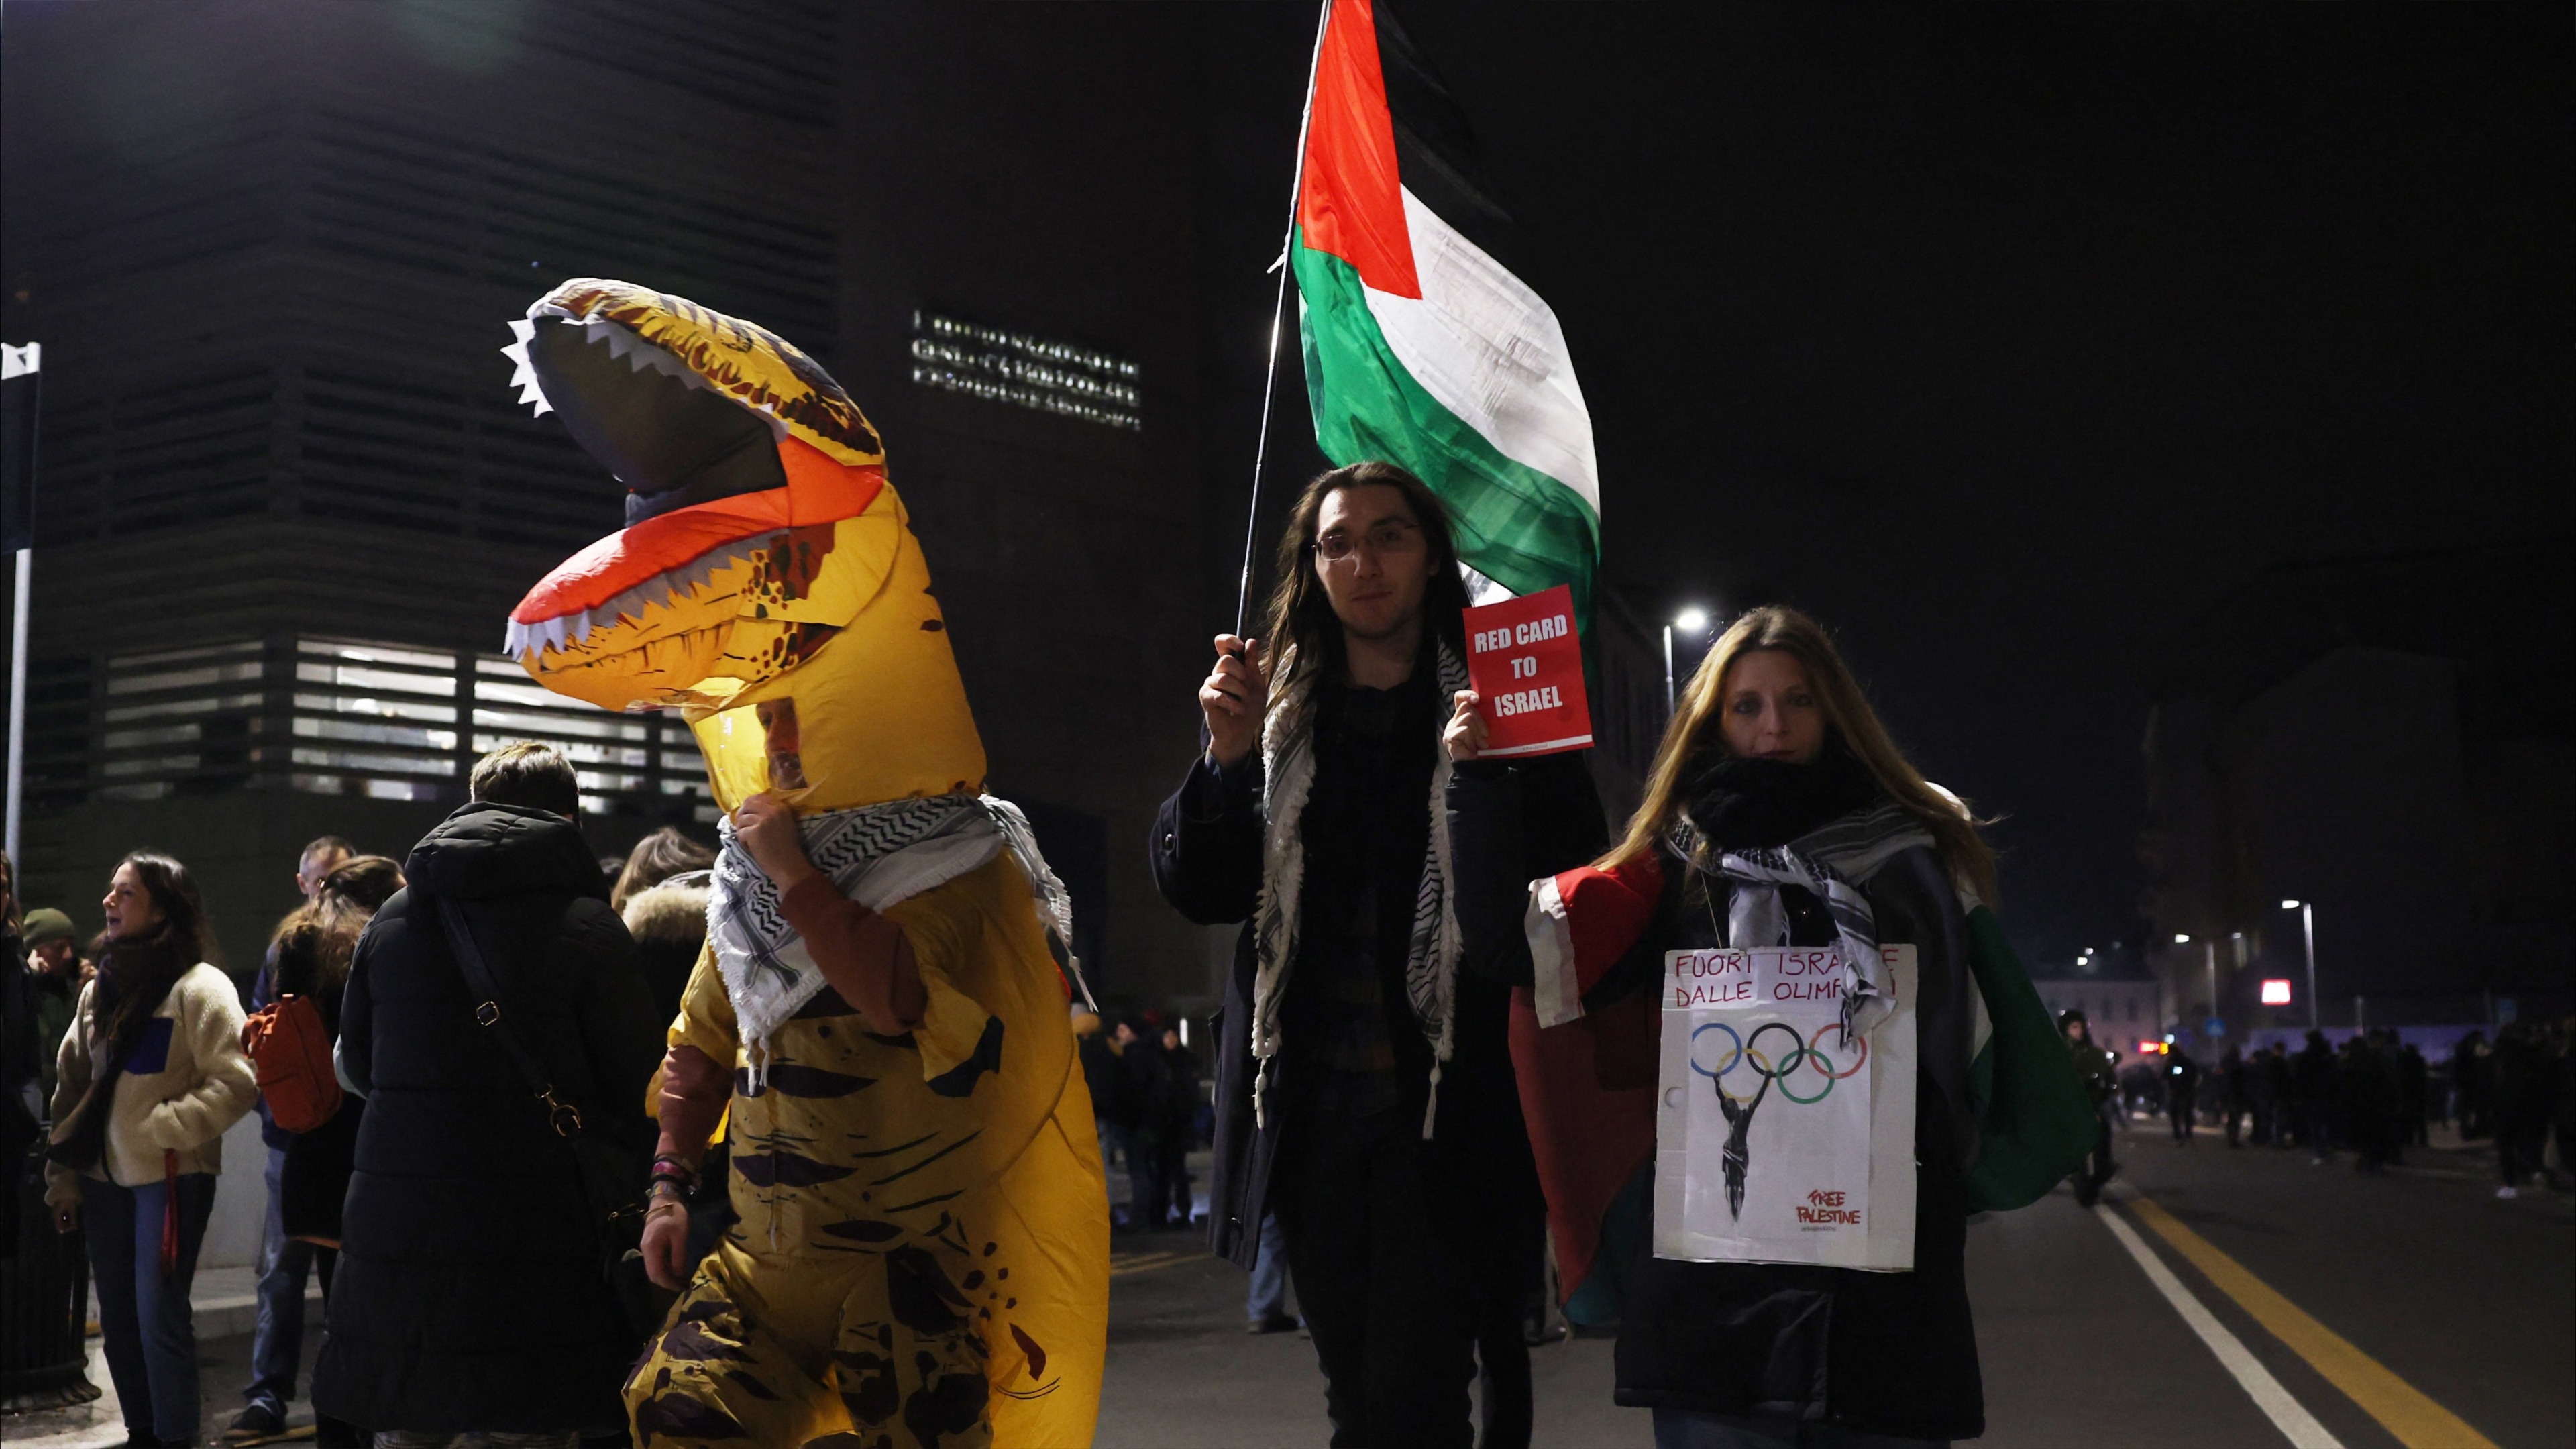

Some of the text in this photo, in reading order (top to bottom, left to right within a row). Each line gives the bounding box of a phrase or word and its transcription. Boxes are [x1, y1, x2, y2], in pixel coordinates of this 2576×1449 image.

[1474, 614, 1568, 653] RED CARD
[1511, 655, 1538, 679] TO
[1494, 686, 1563, 718] ISRAEL
[1676, 949, 1899, 977] FUORI ISRAE
[1676, 981, 1752, 1007] DALLE
[1807, 1189, 1846, 1206] FREE
[1796, 1206, 1861, 1224] PALESTINE
